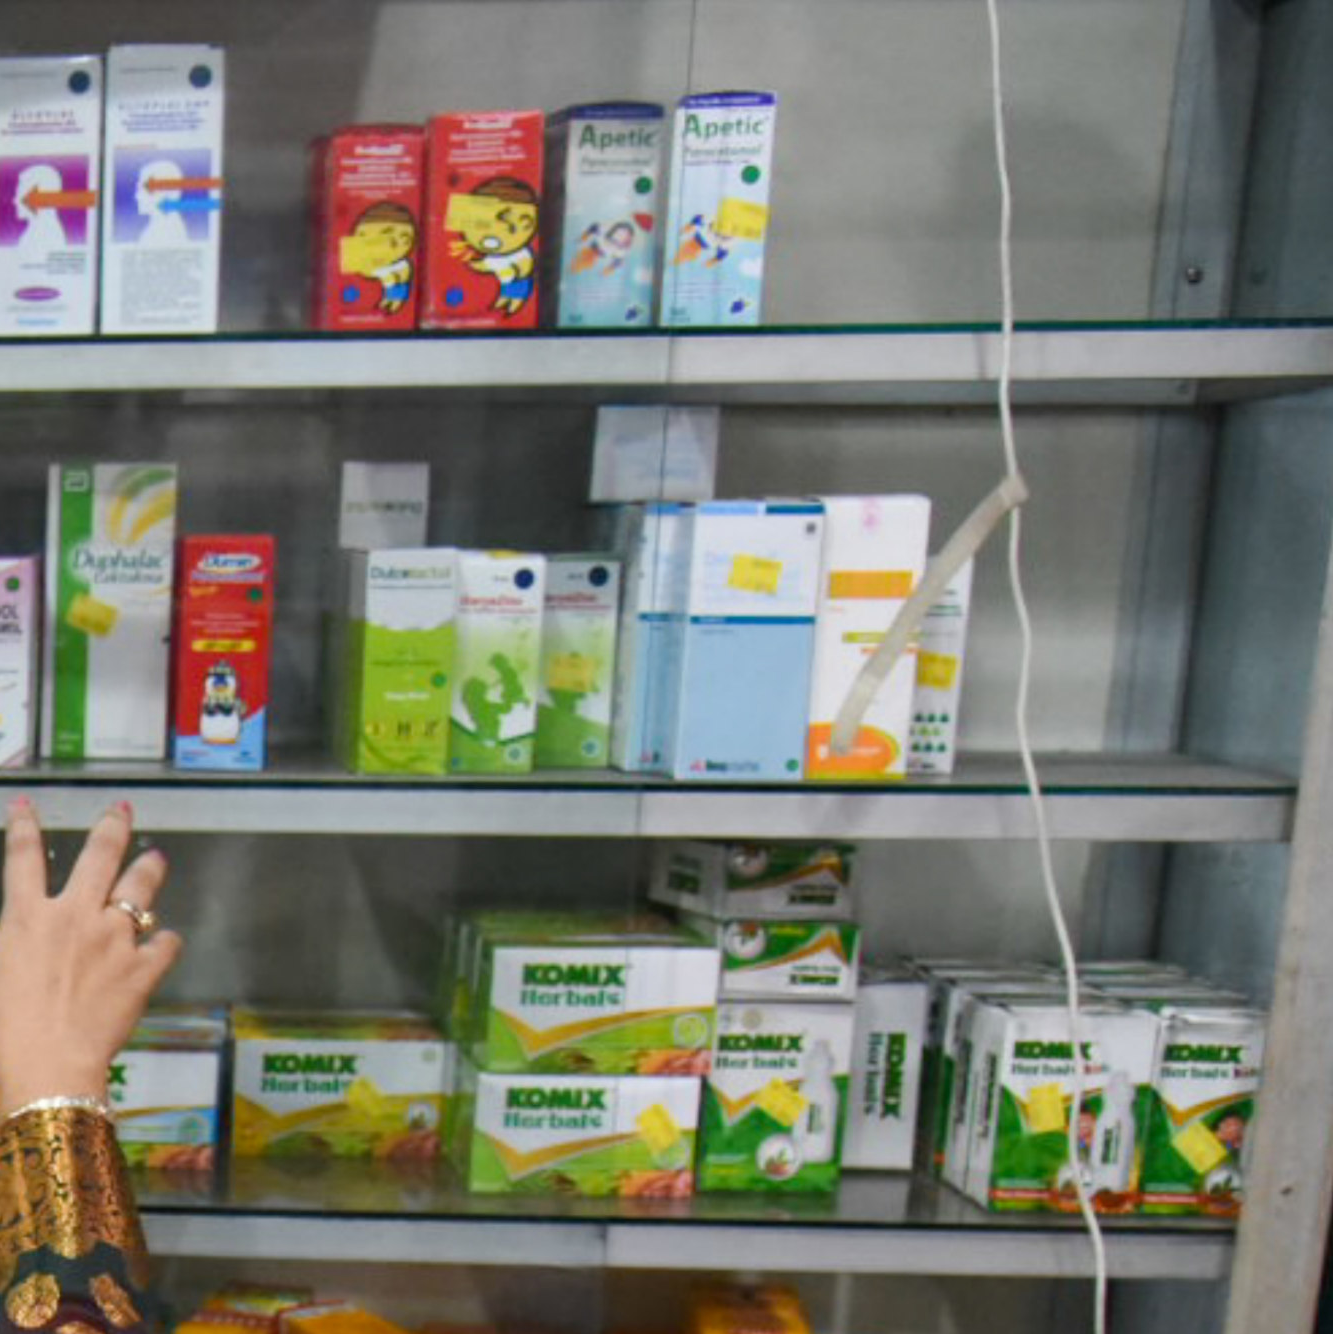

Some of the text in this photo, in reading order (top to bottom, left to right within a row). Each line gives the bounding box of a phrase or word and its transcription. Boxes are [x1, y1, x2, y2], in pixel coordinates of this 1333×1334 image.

[579, 125, 655, 150] Apetic
[684, 113, 764, 139] Apetic
[522, 963, 626, 988] KOMIX
[519, 989, 621, 1008] Herbals
[717, 1033, 805, 1053] KOMIX
[1163, 1043, 1244, 1064] KOMIX
[261, 1052, 358, 1075] KOMIX
[880, 1032, 908, 1120] KOMIX
[505, 1087, 606, 1110] KOMIX
[503, 1112, 603, 1130] Herbals
